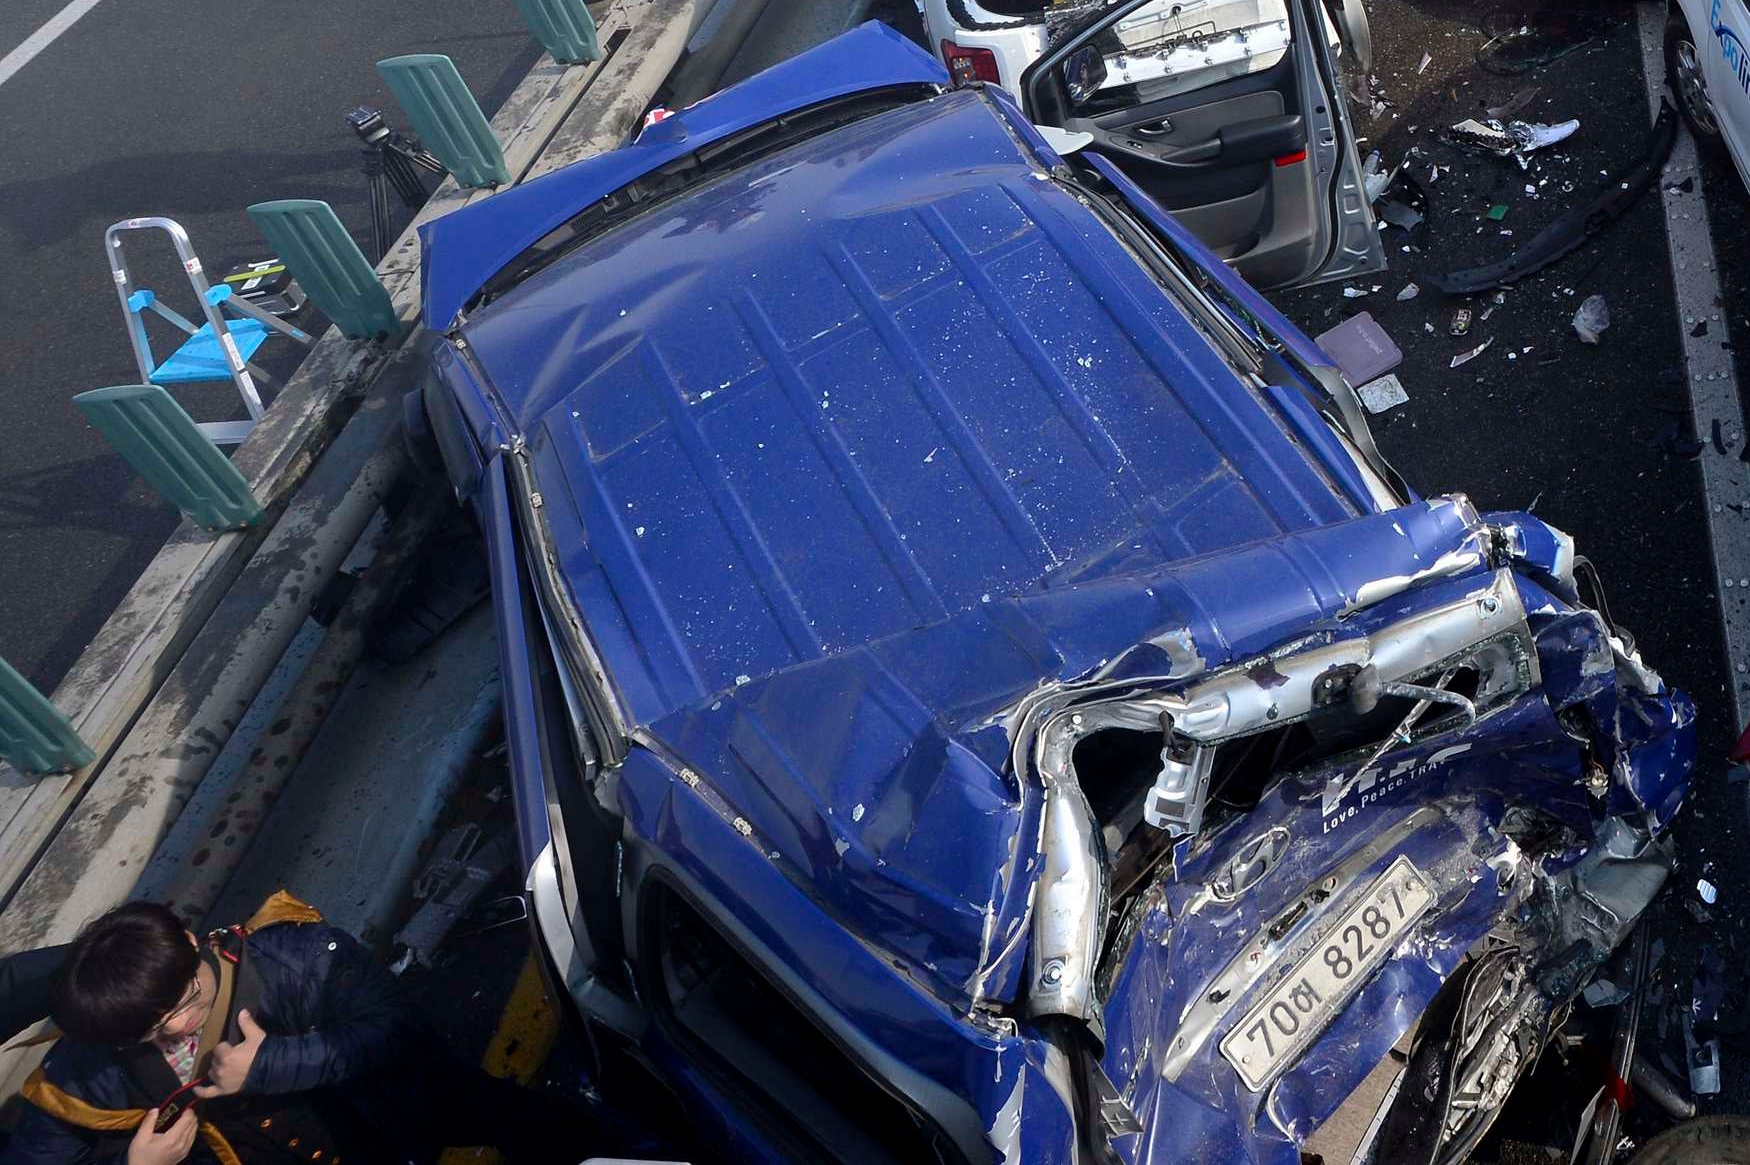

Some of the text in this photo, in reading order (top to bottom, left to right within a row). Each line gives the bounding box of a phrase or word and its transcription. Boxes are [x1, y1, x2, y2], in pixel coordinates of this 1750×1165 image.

[1323, 804, 1359, 835] Love.
[1361, 778, 1407, 809] Peace.
[1246, 984, 1321, 1061] 70허
[1323, 885, 1408, 981] 8287
